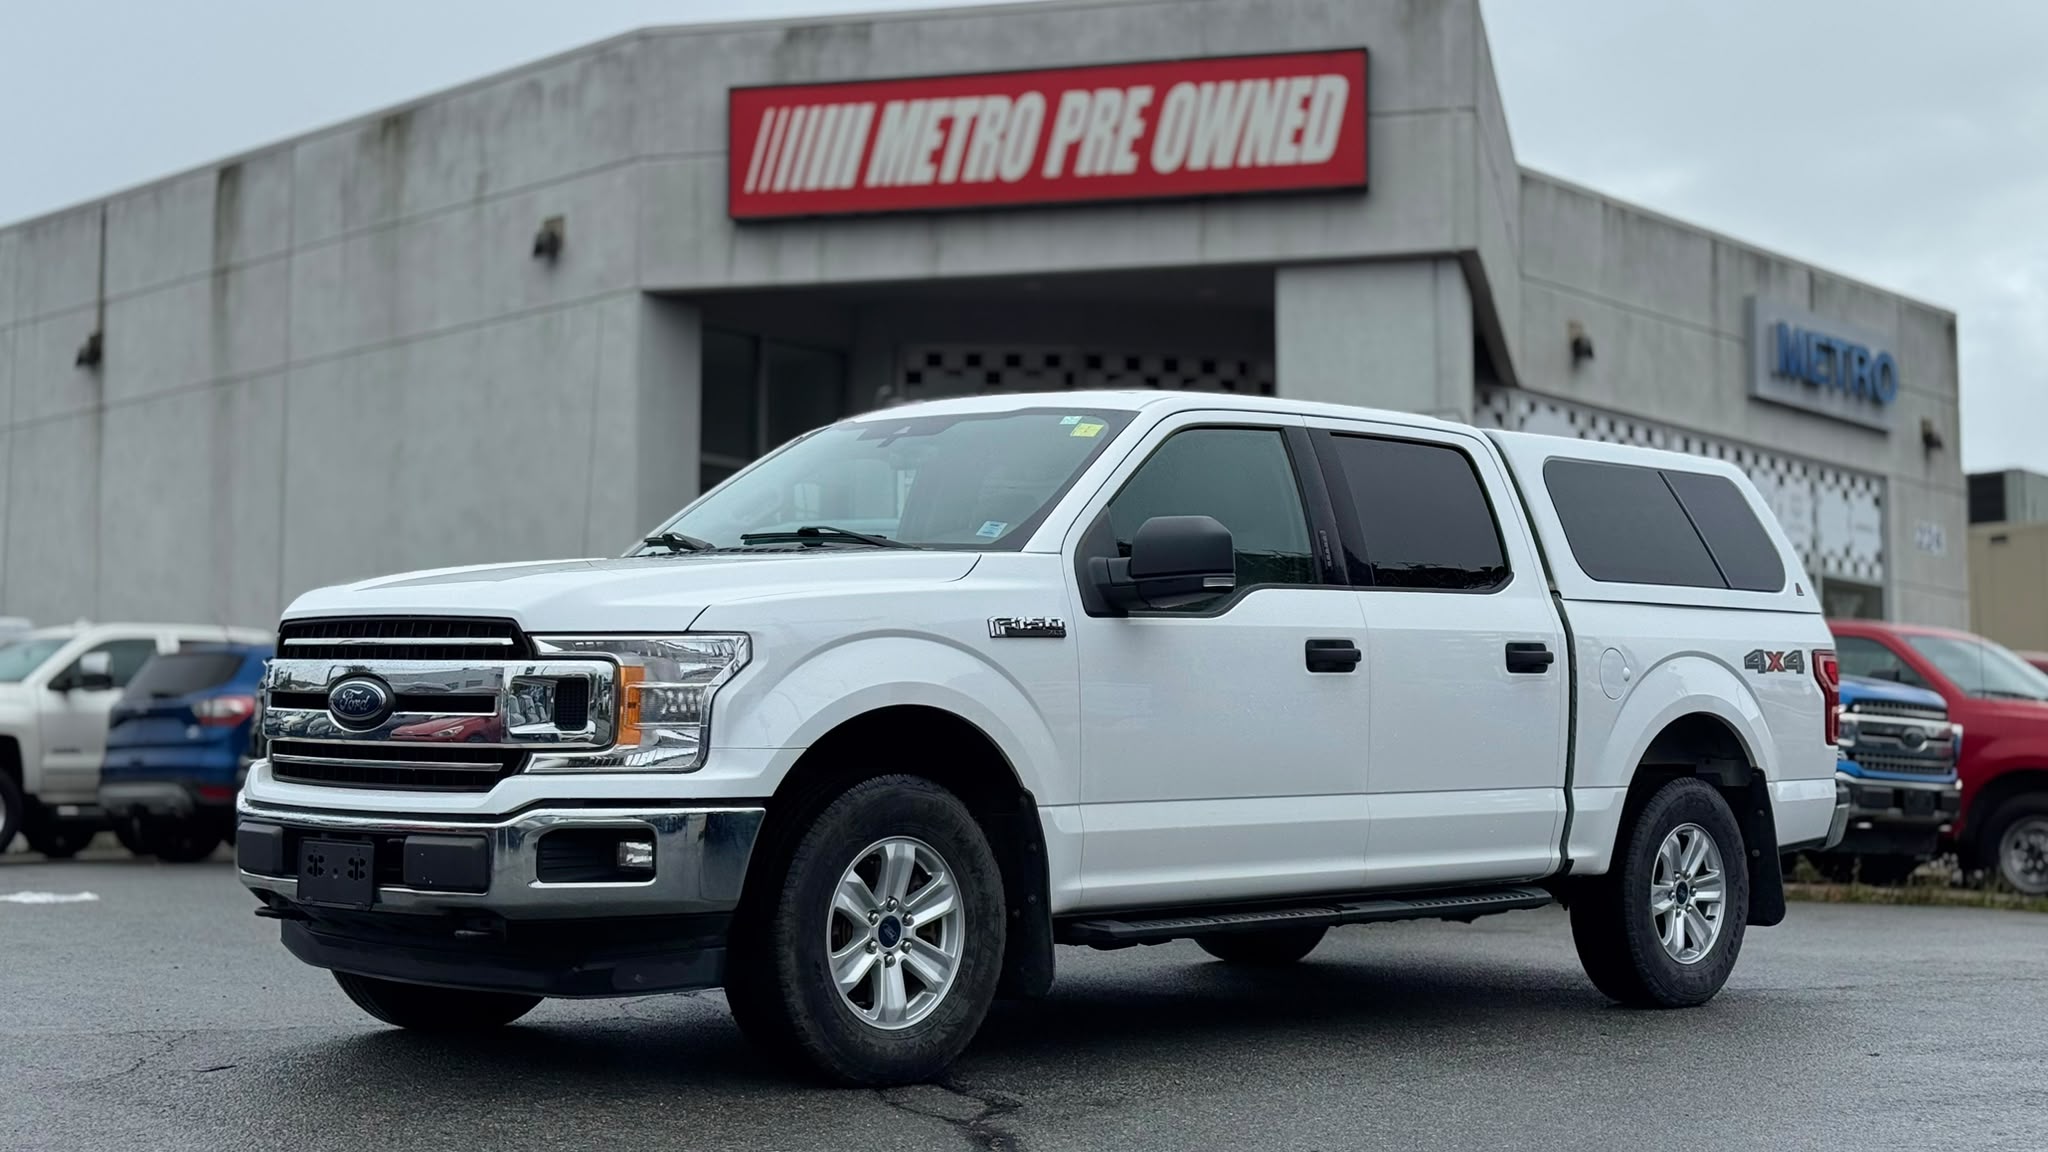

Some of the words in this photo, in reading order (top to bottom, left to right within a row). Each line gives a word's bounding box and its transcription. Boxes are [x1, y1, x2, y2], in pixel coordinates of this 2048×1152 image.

[863, 91, 1046, 188] METRO
[1042, 85, 1154, 179] PRE
[1150, 74, 1349, 175] OWNED
[1776, 321, 1898, 406] METRO
[340, 688, 370, 711] Ford
